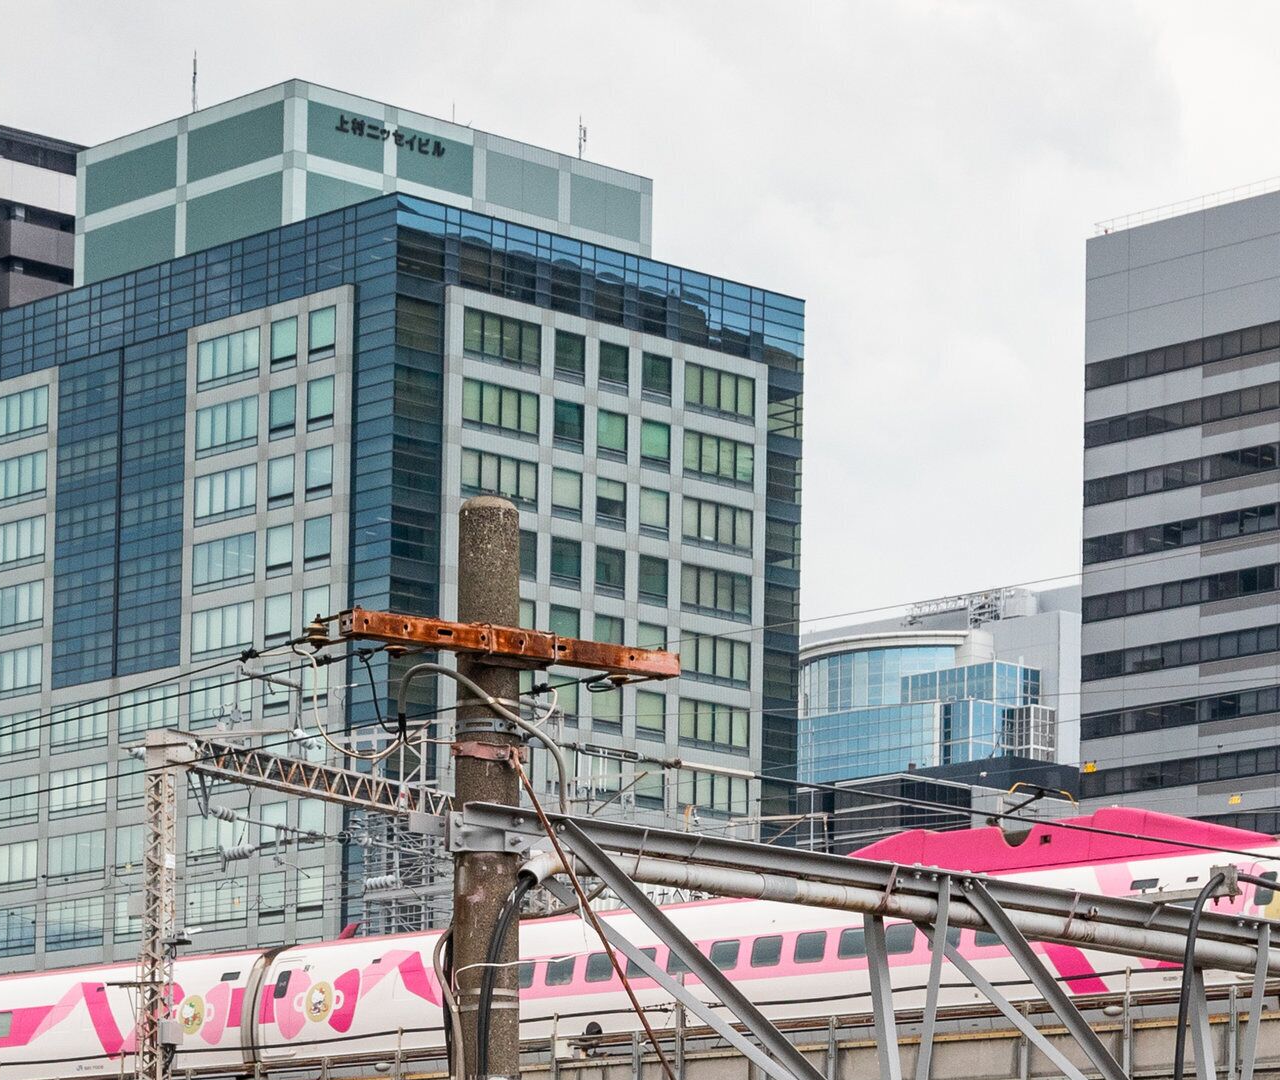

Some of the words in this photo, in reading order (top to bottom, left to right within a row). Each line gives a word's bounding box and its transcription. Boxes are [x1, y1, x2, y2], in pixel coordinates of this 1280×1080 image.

[335, 114, 446, 158] 上村ニッセイビル
